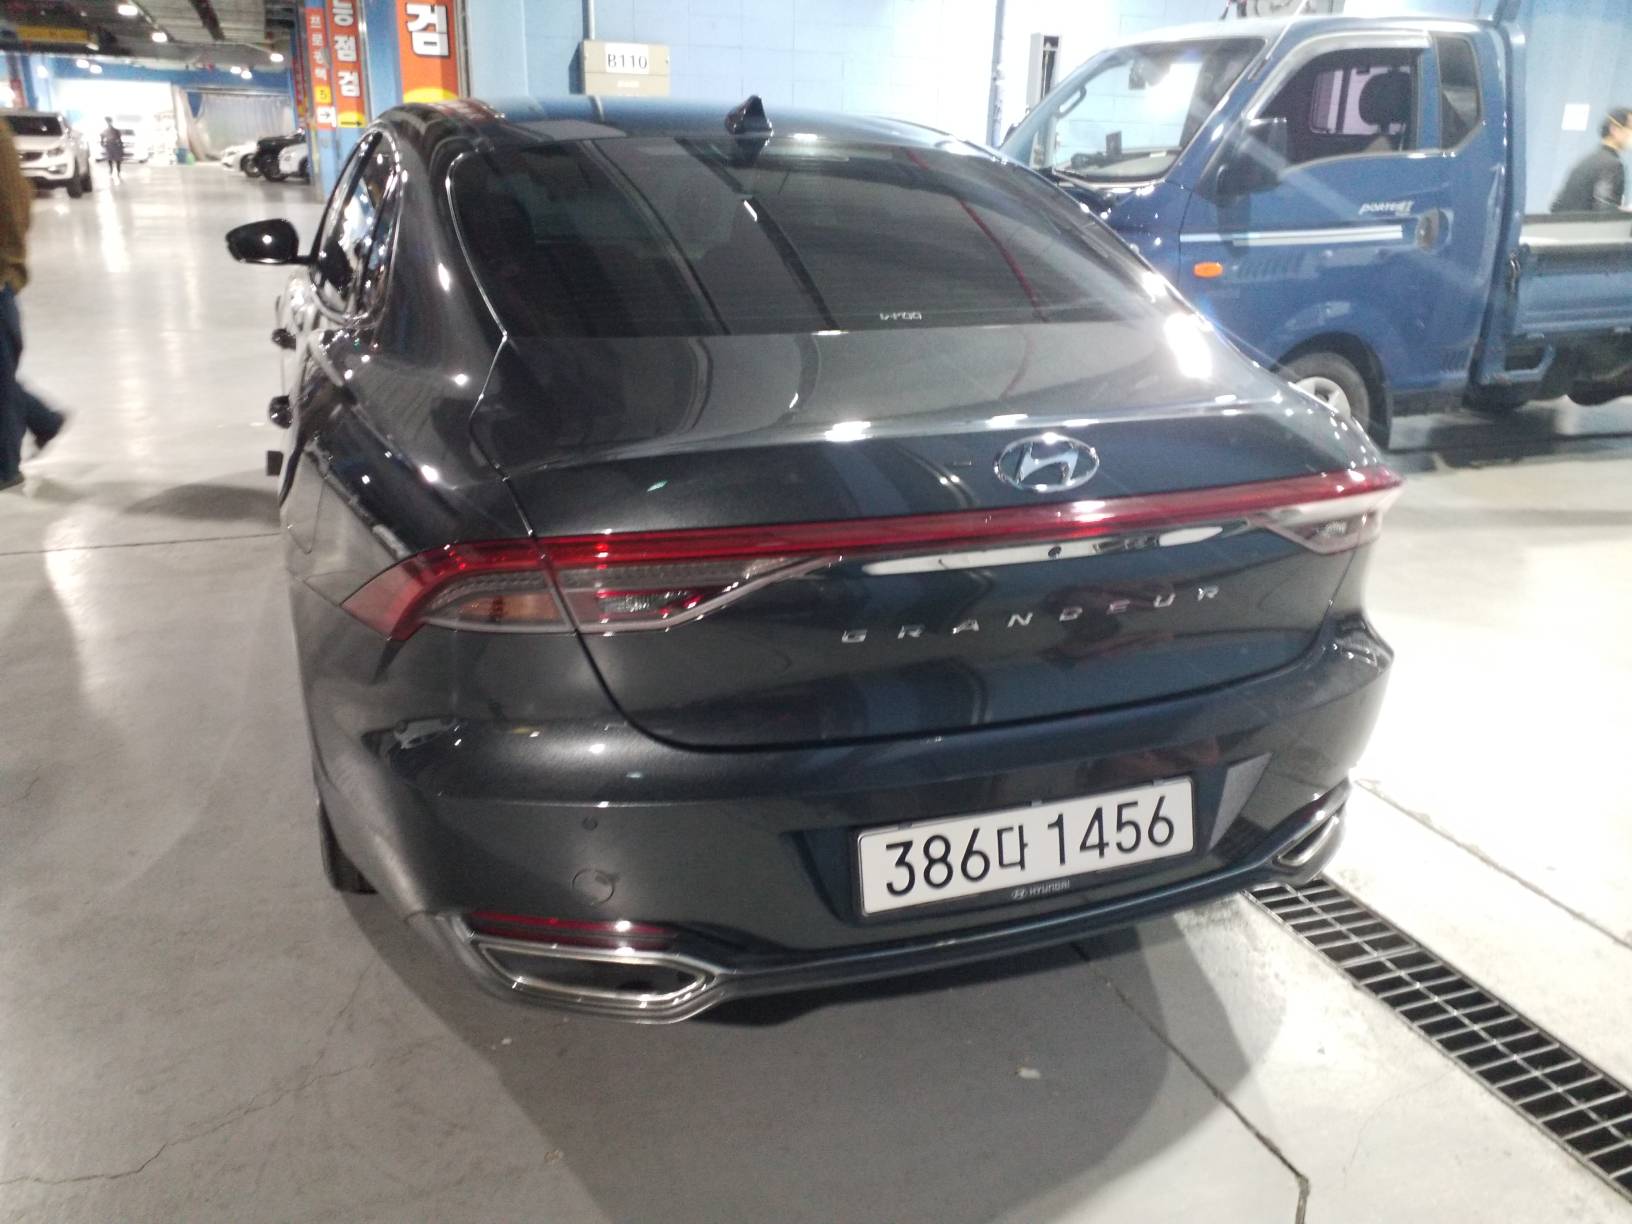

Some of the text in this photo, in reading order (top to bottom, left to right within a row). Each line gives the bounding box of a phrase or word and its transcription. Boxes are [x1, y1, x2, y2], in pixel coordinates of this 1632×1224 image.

[405, 3, 450, 57] 검
[607, 53, 648, 69] B110
[841, 585, 1219, 643] GRANDEUR
[885, 795, 1175, 897] 386다 1456
